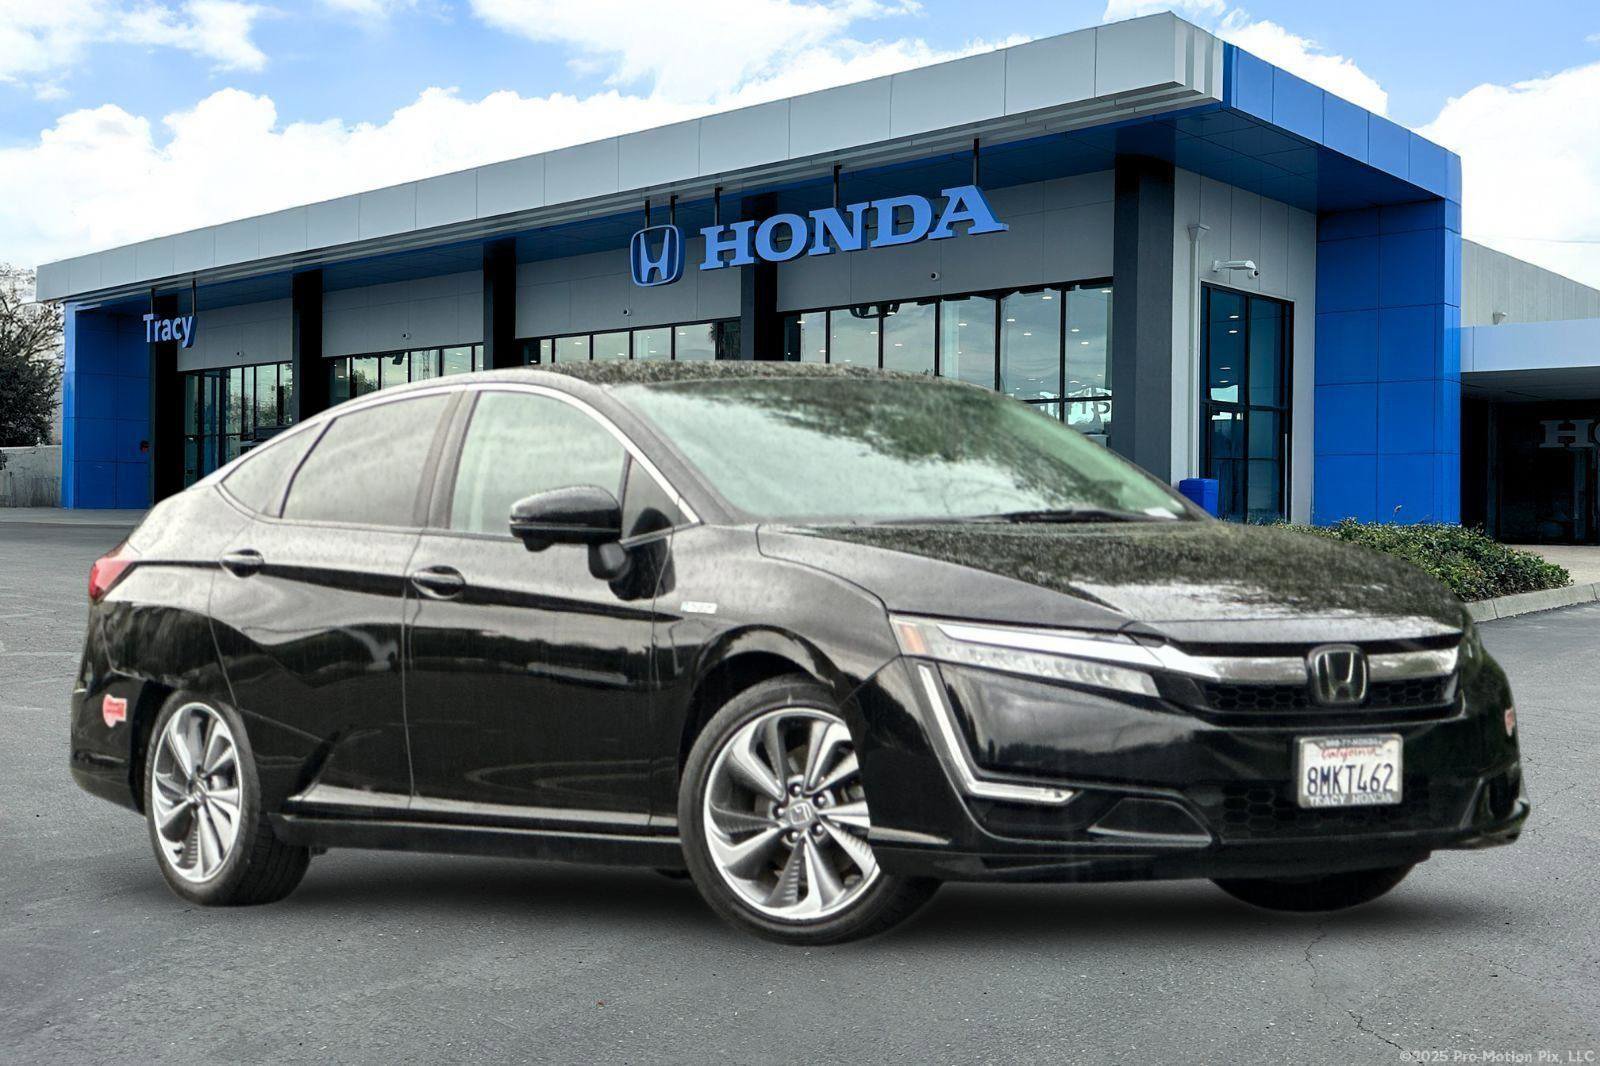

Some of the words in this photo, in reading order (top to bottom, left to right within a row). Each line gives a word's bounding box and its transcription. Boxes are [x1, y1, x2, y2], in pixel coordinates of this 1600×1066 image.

[700, 184, 1009, 270] HONDA
[143, 314, 194, 349] Tracy
[1307, 763, 1393, 796] 8MKT462
